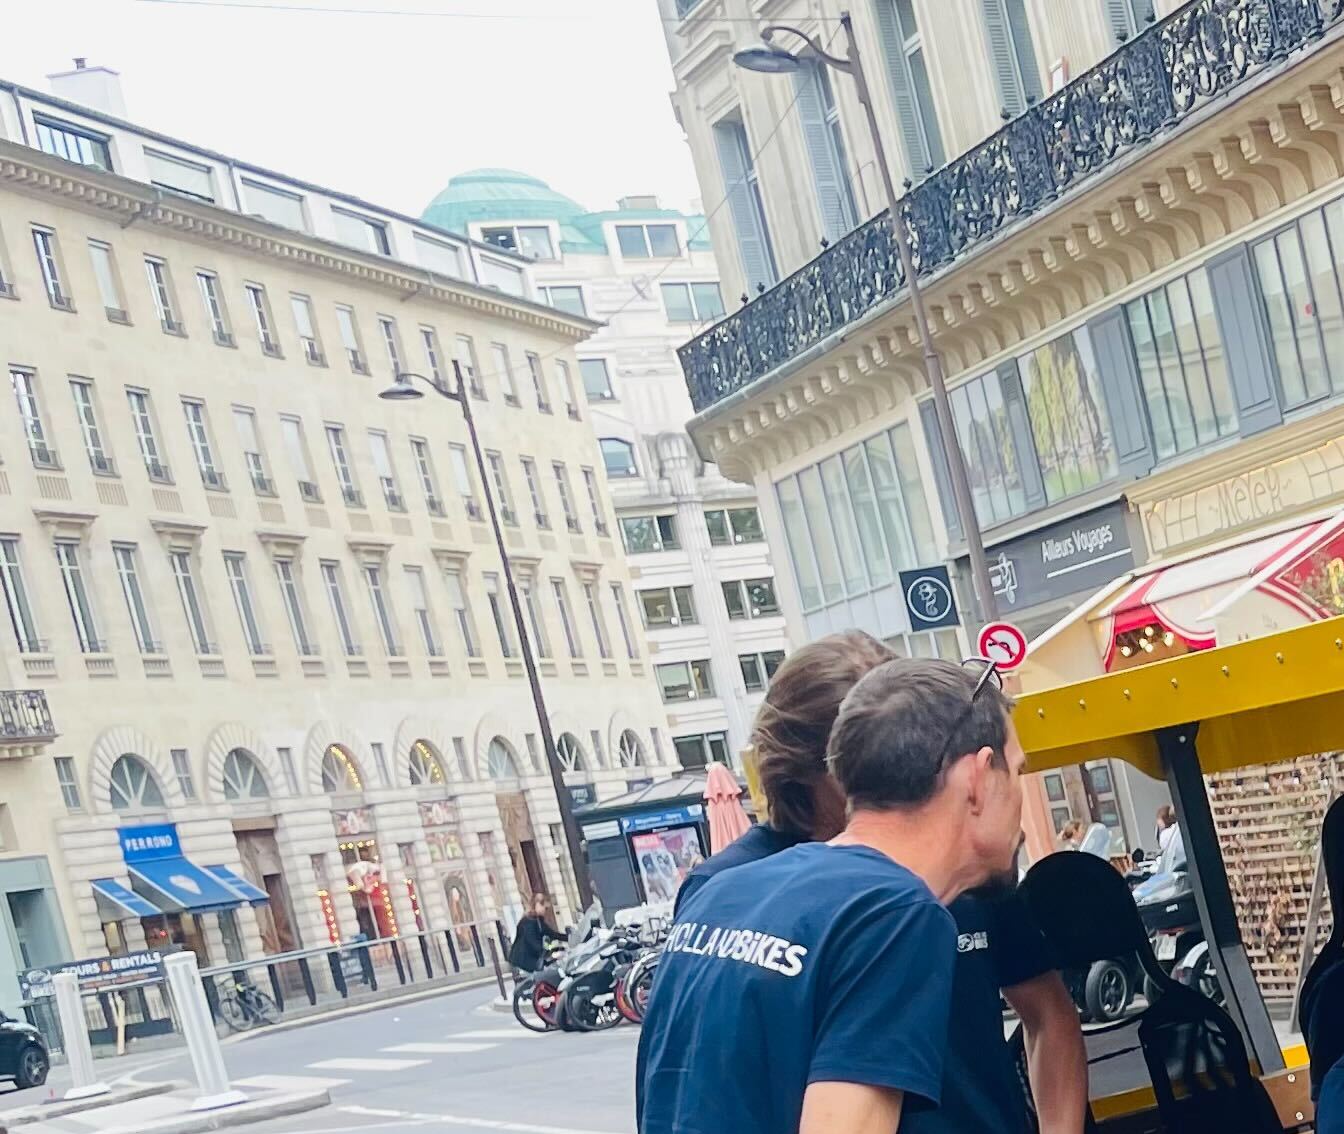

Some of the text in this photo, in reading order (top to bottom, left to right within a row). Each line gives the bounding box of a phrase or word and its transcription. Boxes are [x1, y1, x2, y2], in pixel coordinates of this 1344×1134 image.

[1041, 524, 1113, 563] Ailleurs Voyages
[111, 952, 162, 970] RENTALS
